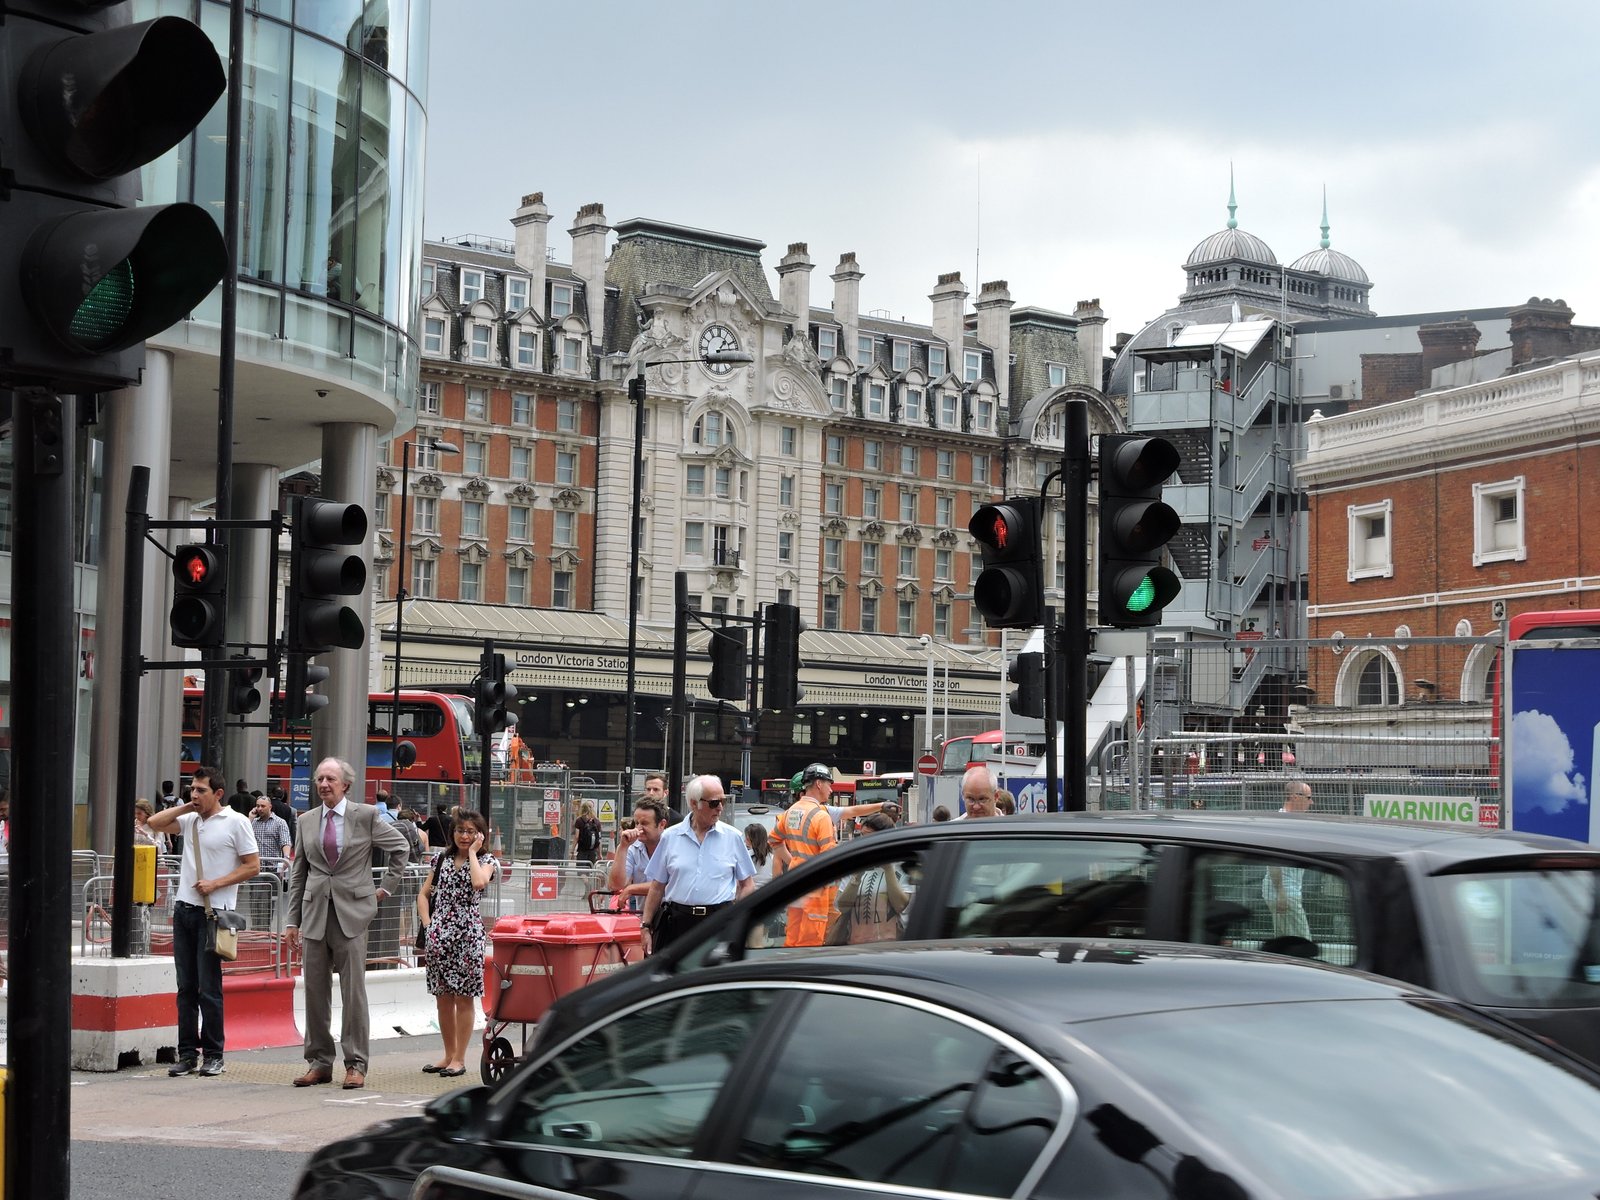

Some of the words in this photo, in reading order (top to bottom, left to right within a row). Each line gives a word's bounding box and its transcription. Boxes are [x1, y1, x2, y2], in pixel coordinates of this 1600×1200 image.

[515, 652, 553, 664] London
[556, 653, 594, 667] Victoria
[864, 674, 896, 685] London
[933, 677, 960, 689] Staion
[887, 779, 897, 787] 507
[1368, 800, 1473, 822] WARNING
